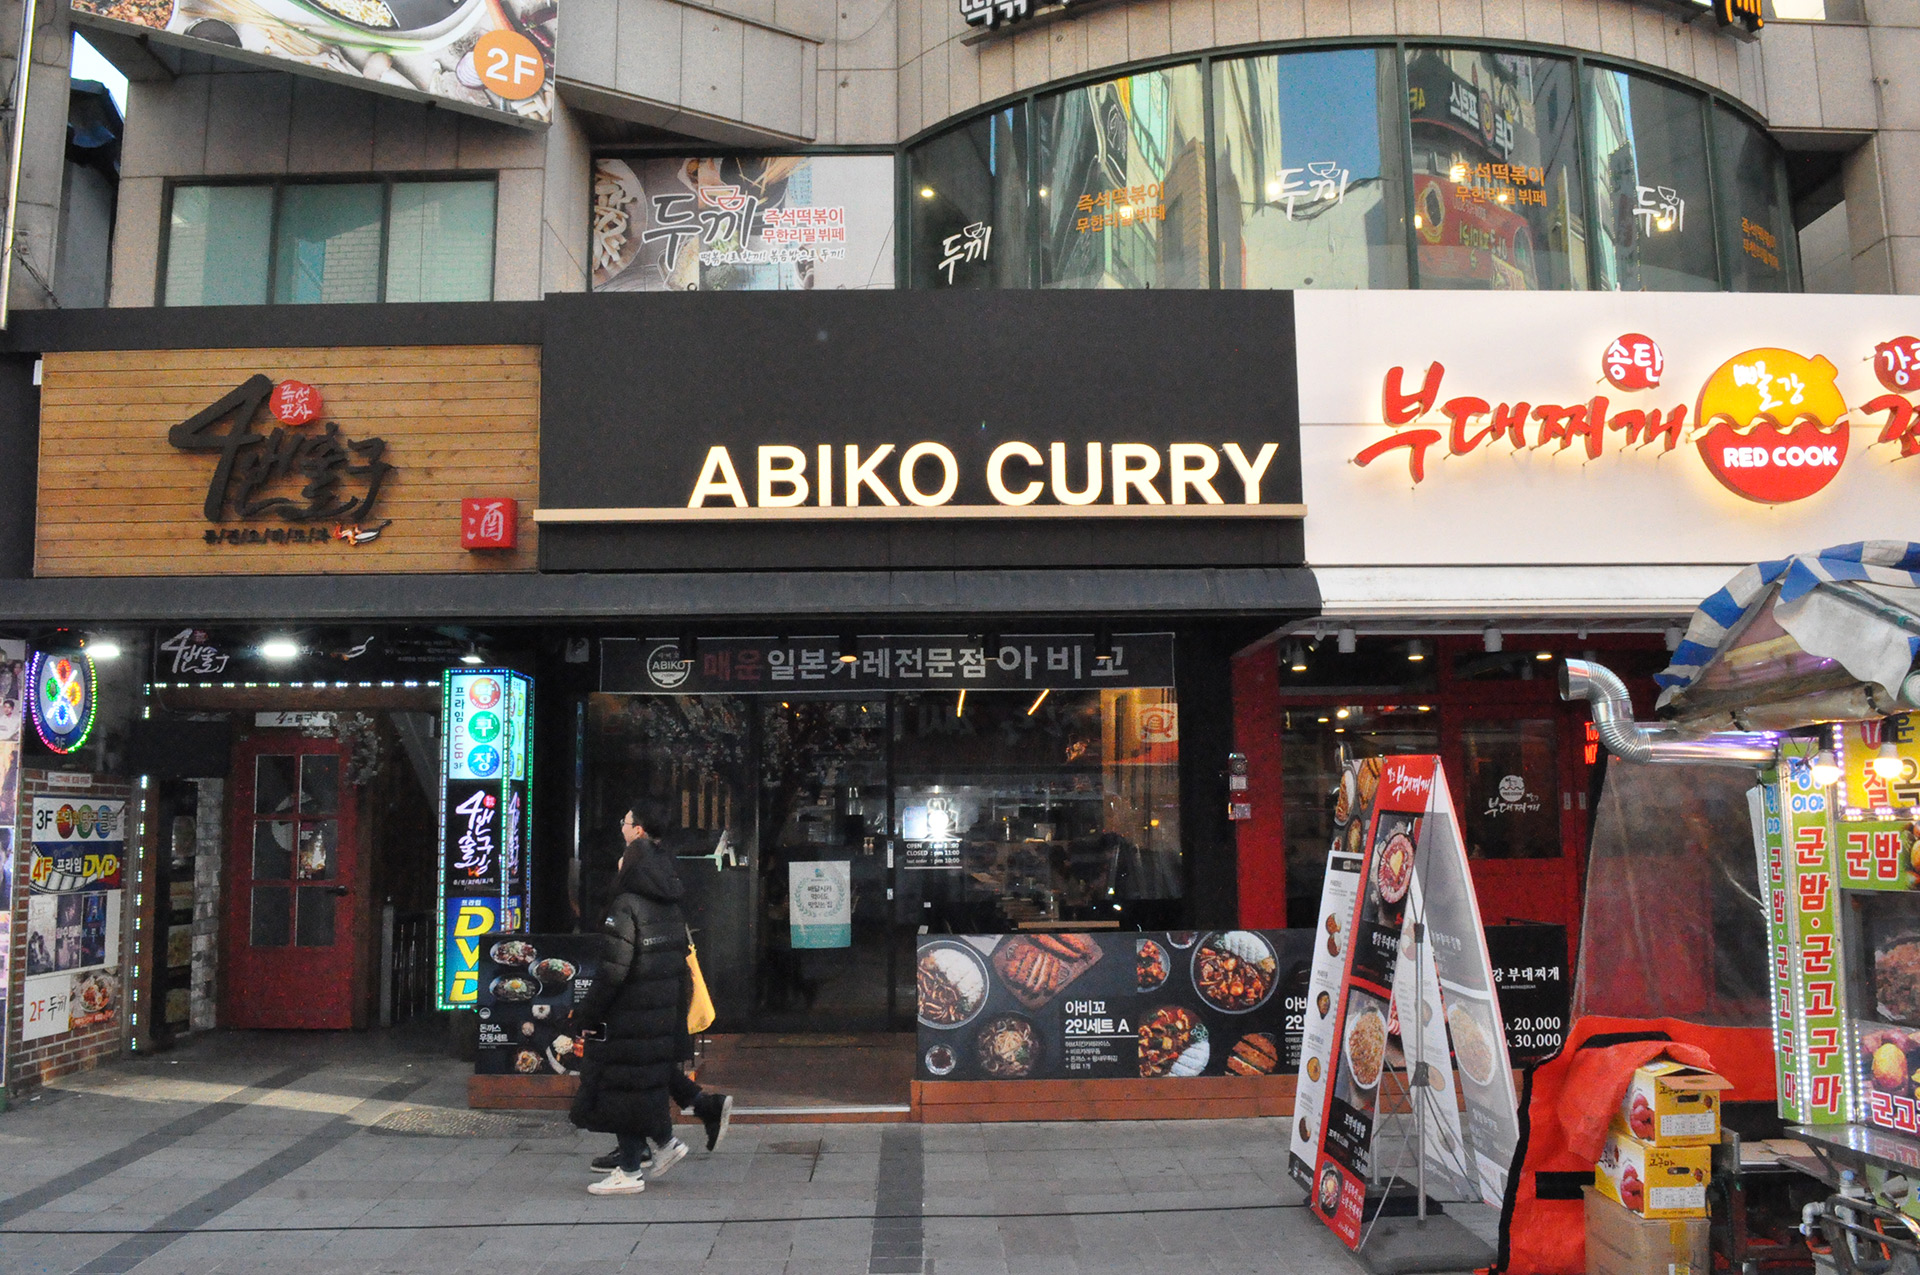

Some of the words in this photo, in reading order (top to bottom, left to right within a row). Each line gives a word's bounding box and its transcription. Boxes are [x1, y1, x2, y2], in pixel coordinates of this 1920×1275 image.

[486, 47, 538, 85] 2F
[1077, 181, 1165, 212] 즉석떡볶이
[1273, 164, 1348, 220] 두끼
[764, 208, 844, 226] 즉석떡볶이
[1136, 204, 1166, 223] 뷔페
[1633, 186, 1685, 238] 두끼
[643, 193, 757, 271] 두끼
[762, 227, 816, 243] 무한리필
[817, 227, 845, 242] 뷔페
[939, 224, 991, 284] 두끼
[1607, 340, 1662, 382] 송탄
[1354, 361, 1688, 484] 부대찌개
[1723, 446, 1769, 467] RED
[1772, 446, 1838, 467] COOK
[689, 442, 960, 508] ABIKO
[986, 442, 1279, 506] CURRY
[466, 503, 504, 542] 酒
[652, 660, 686, 670] ABIKO
[703, 651, 761, 681] 매운
[767, 647, 986, 680] 일본카레전문점
[455, 686, 464, 723] 프라임
[454, 725, 465, 759] CLUB
[472, 682, 497, 772] 당구장
[453, 762, 463, 770] 3F
[36, 809, 54, 830] 3F
[32, 856, 53, 882] 4F
[56, 857, 83, 873] 프라임
[83, 854, 118, 877] DVD
[1846, 831, 1902, 879] 군밤
[1508, 966, 1560, 982] 부대찌개
[29, 999, 46, 1023] 2F
[1065, 1000, 1107, 1016] 아비꼬
[1065, 1018, 1115, 1034] 2인세트
[1117, 1018, 1130, 1033] A
[1514, 1017, 1561, 1032] 20,000
[1515, 1033, 1562, 1049] 30,000
[1871, 1091, 1920, 1132] 군고
